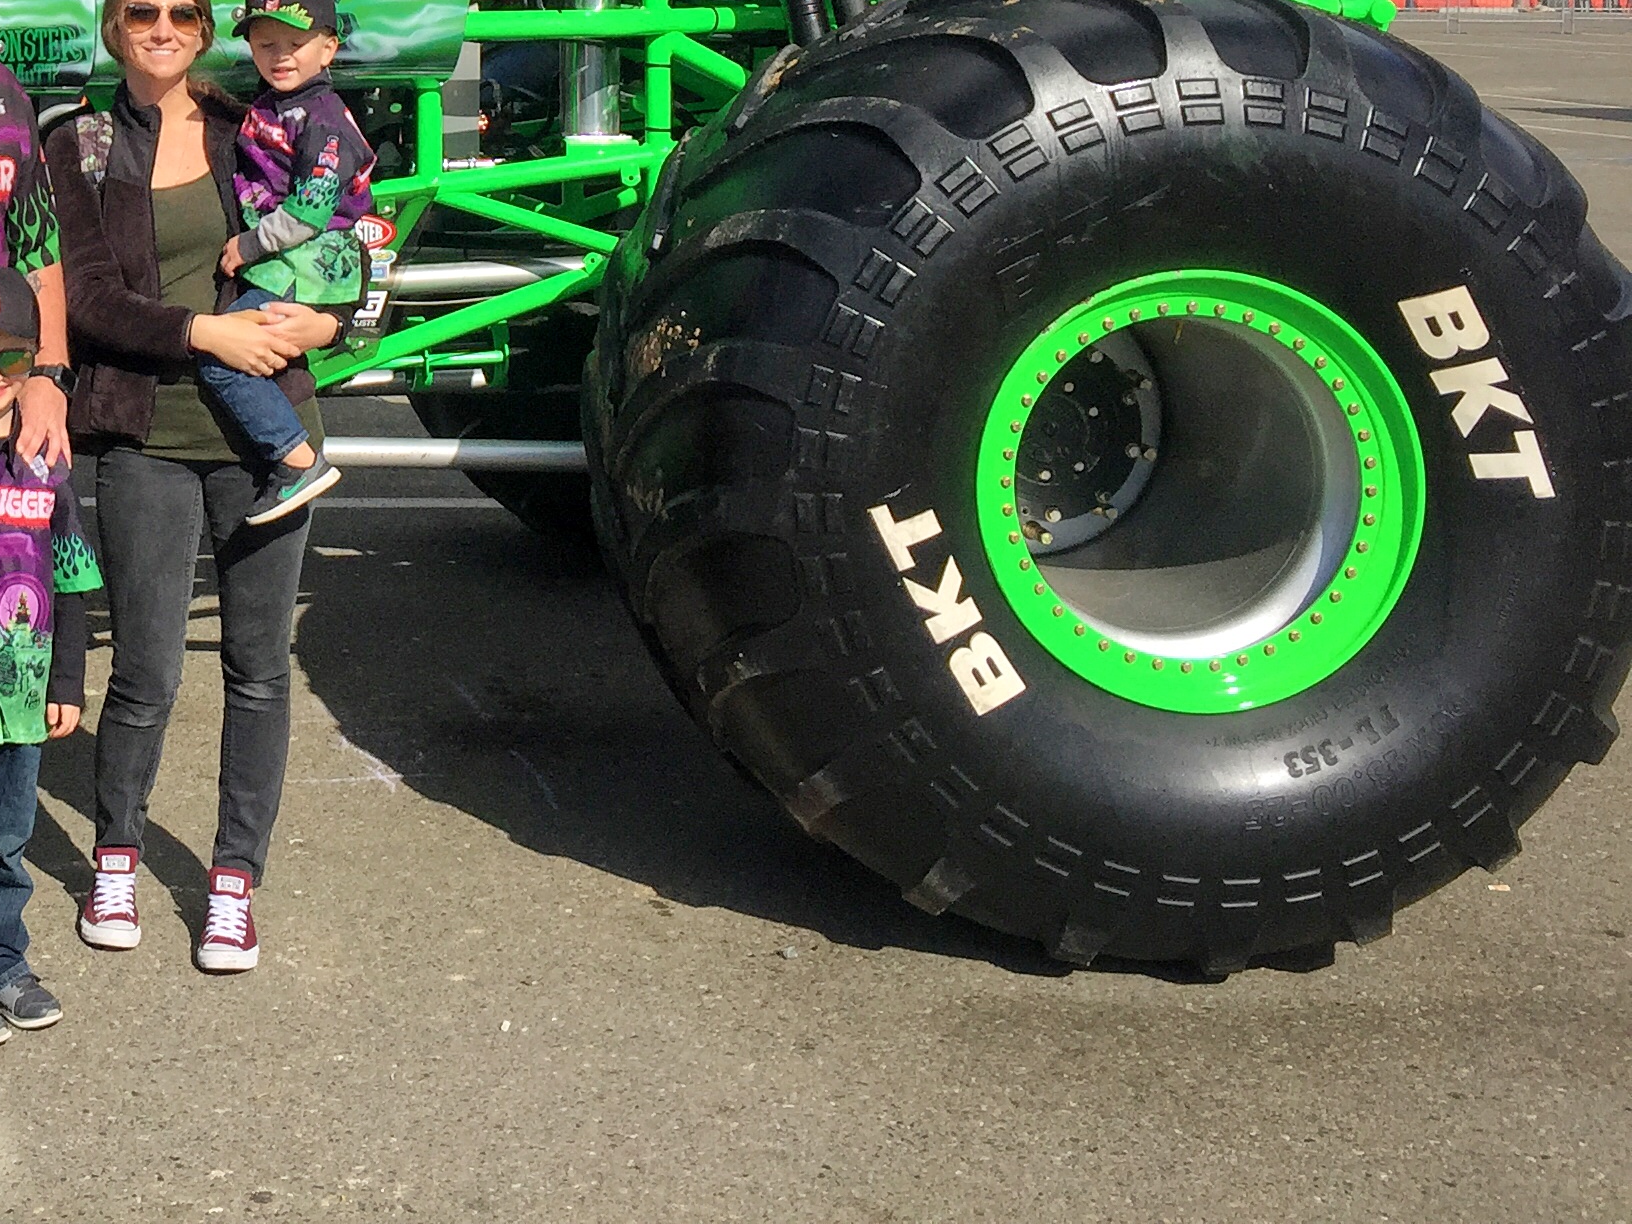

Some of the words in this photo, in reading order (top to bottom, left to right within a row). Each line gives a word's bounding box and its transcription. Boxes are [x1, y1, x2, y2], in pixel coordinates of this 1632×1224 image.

[1397, 284, 1557, 500] BKT
[867, 504, 1028, 717] BKT
[1283, 703, 1401, 779] FL-353
